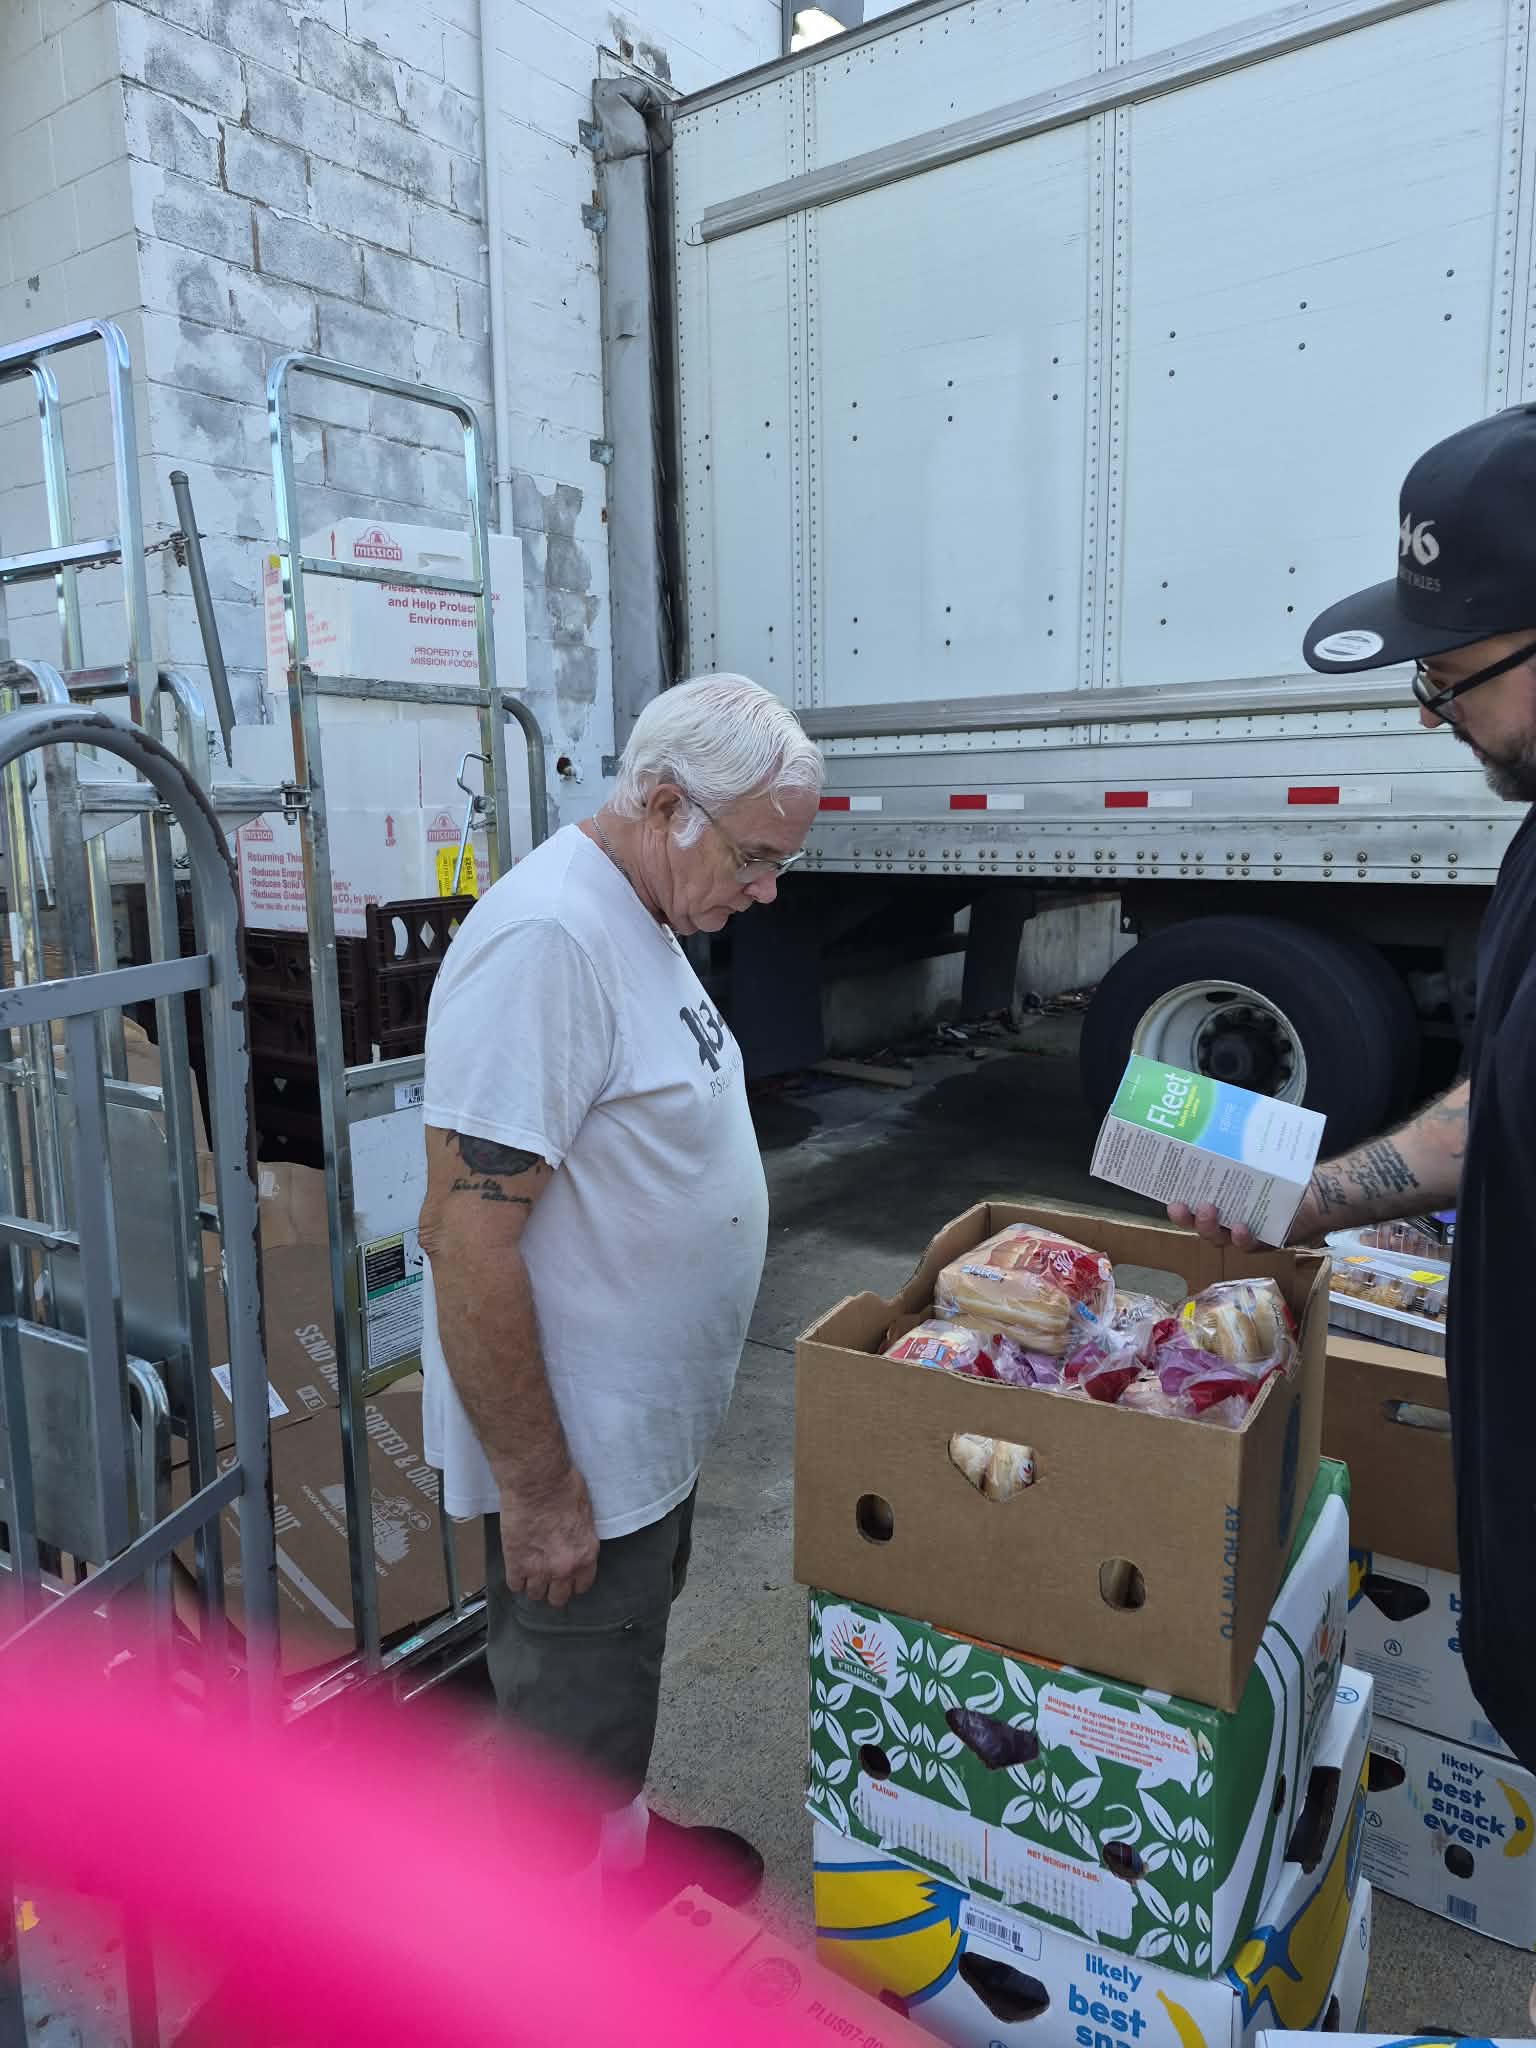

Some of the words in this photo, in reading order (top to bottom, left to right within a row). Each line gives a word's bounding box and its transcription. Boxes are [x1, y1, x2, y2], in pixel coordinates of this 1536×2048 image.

[354, 544, 402, 560] mission
[388, 597, 409, 608] and
[412, 599, 436, 612] Help
[410, 657, 446, 667] MISSION
[449, 659, 478, 668] FOODS
[414, 648, 460, 657] PROPERTY
[463, 649, 474, 658] OF
[427, 830, 461, 841] mission
[1147, 1072, 1192, 1129] Fleet
[838, 1660, 880, 1685] FRUPICK
[1441, 1752, 1485, 1780] likely
[1427, 1771, 1486, 1808] best
[1452, 1772, 1473, 1786] the
[1424, 1813, 1491, 1848] ever
[1432, 1798, 1505, 1838] snack
[1085, 1952, 1143, 1993] likely
[1099, 1980, 1129, 2003] the
[1068, 1983, 1147, 2039] best
